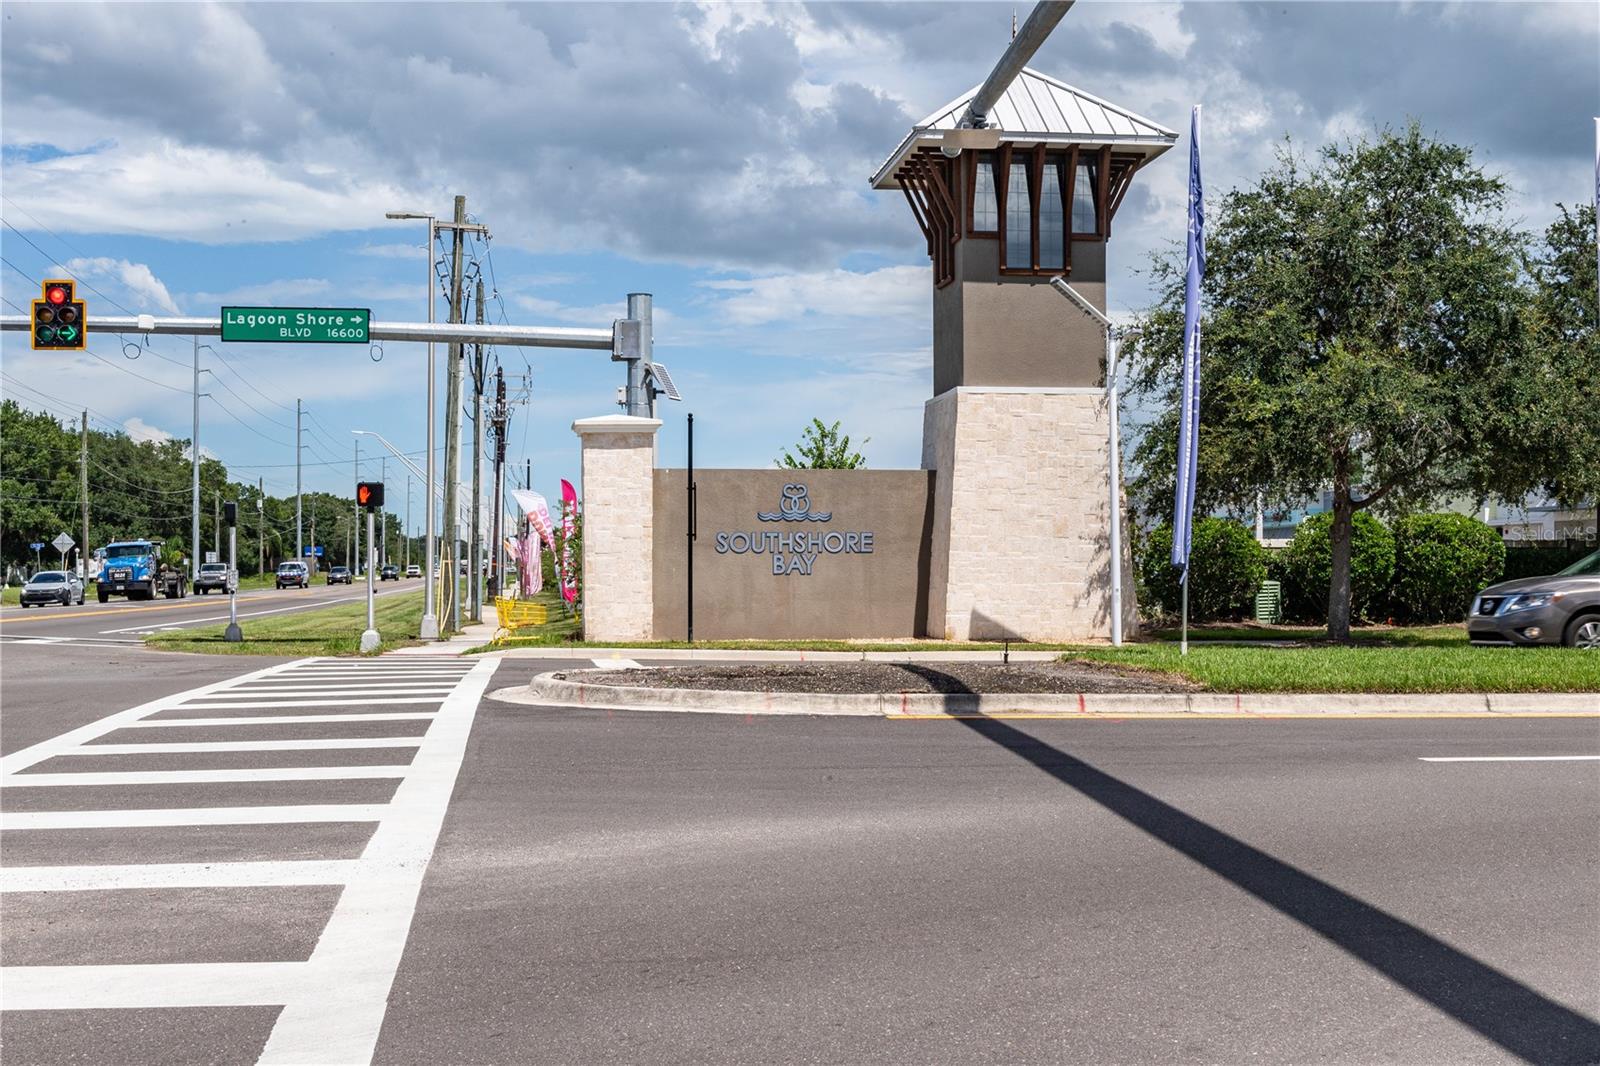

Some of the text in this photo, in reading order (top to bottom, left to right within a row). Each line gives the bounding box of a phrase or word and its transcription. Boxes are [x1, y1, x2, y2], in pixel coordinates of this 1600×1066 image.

[227, 312, 344, 328] Lagoon Shore
[280, 328, 364, 338] BLVD 16600
[715, 531, 873, 553] SOUTHSHORE
[772, 553, 817, 575] BAY
